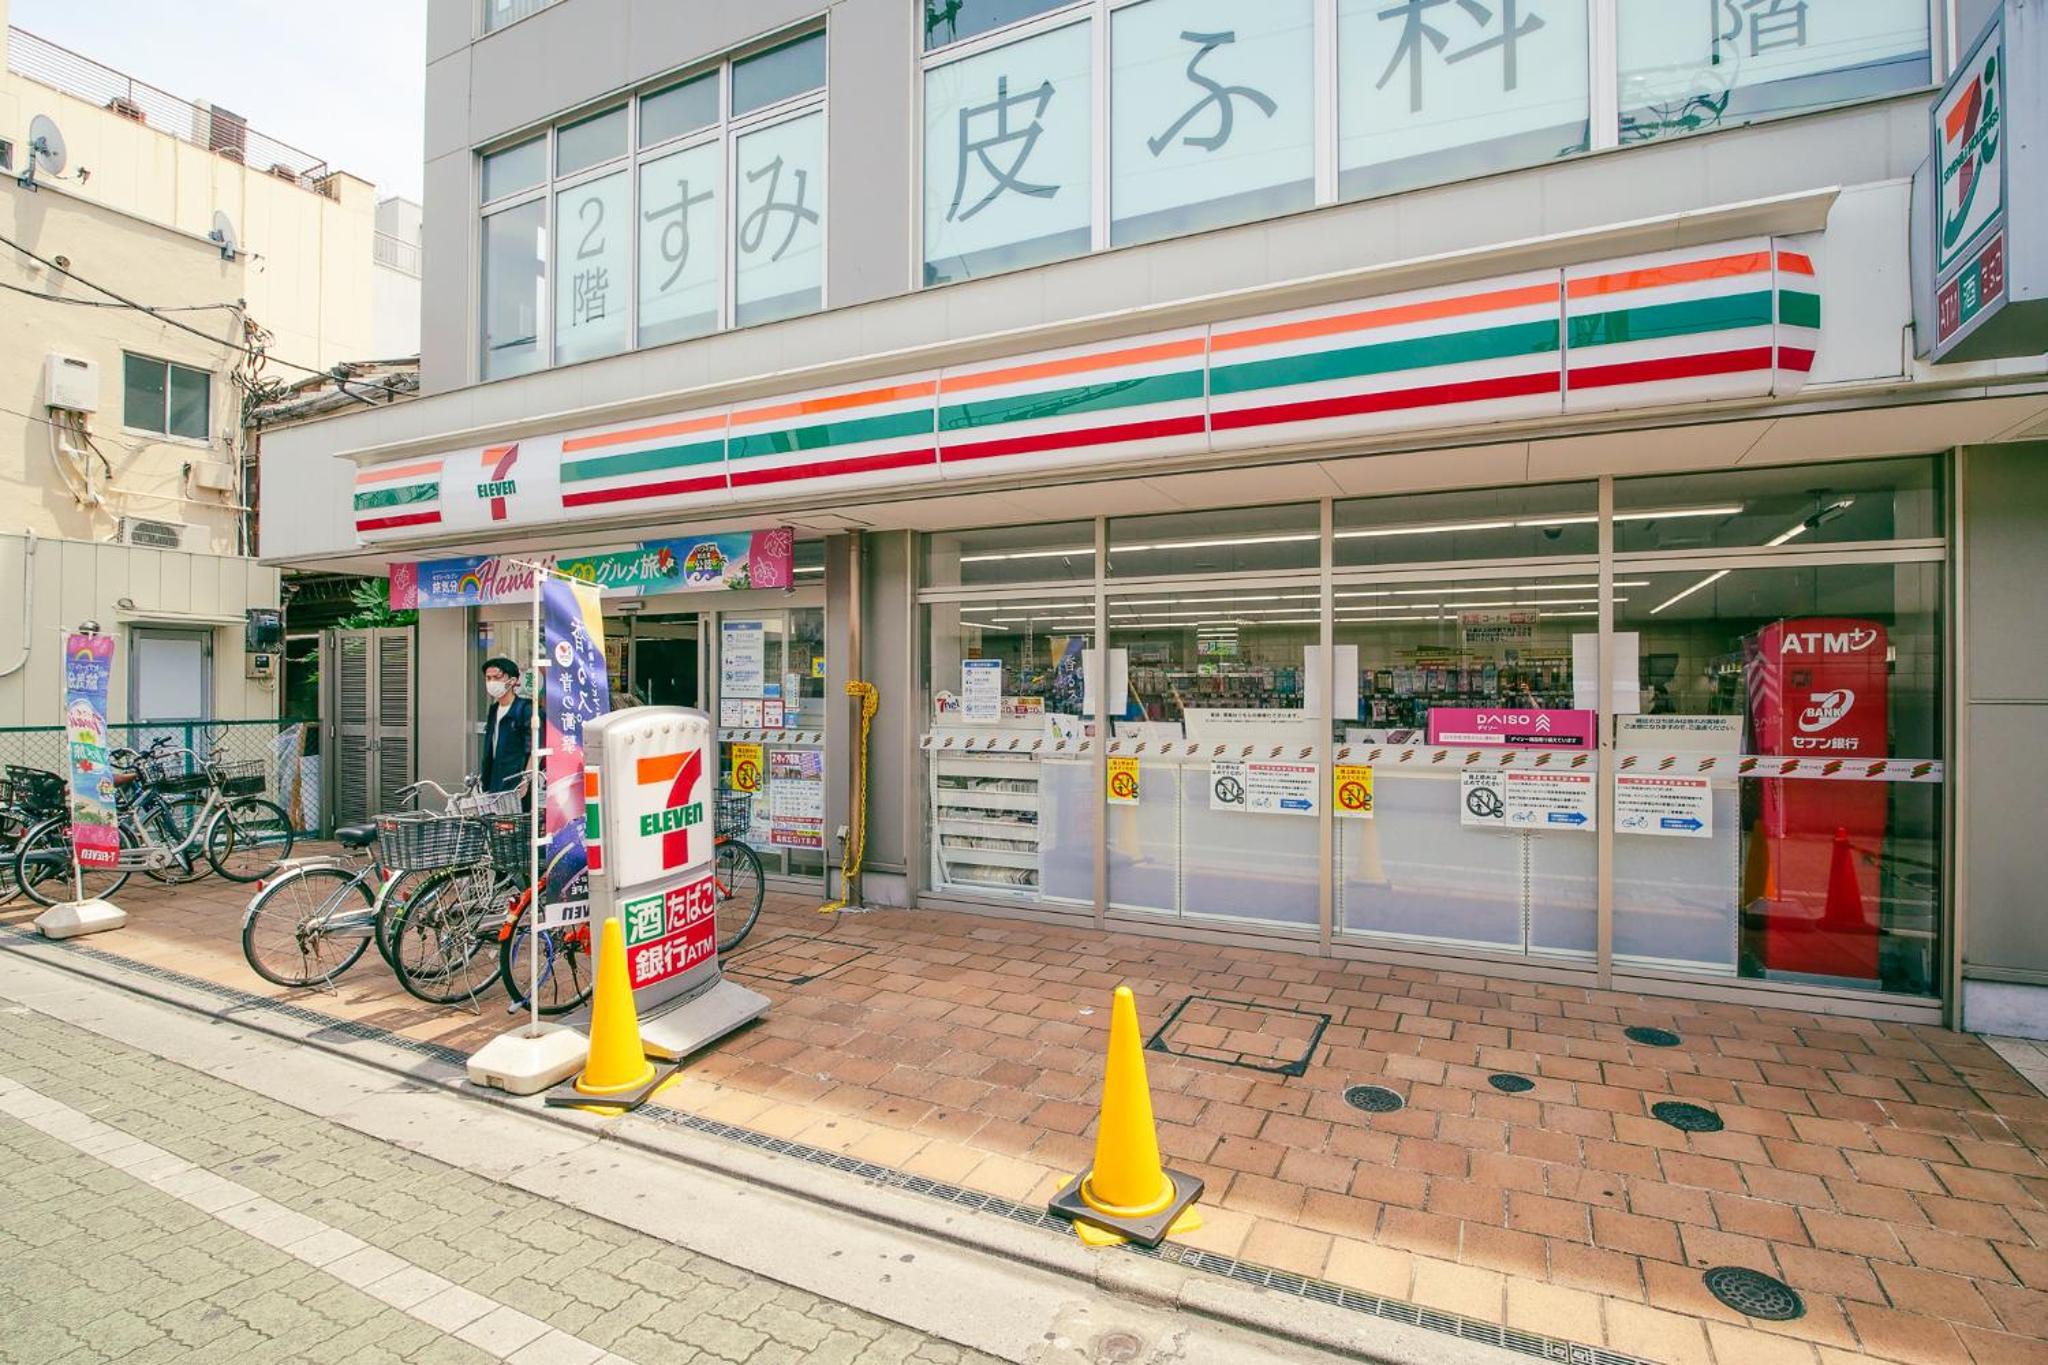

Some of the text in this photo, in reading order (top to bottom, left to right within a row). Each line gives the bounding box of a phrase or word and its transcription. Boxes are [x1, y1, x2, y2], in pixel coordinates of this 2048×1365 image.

[571, 196, 609, 327] 2階
[480, 442, 520, 520] 7
[596, 553, 661, 583] グルメ旅
[1476, 714, 1531, 725] DAISO
[1806, 706, 1843, 719] BANK
[1791, 736, 1860, 750] セブン銀行
[636, 747, 702, 870] 7
[628, 882, 715, 943] 酒 たばこ
